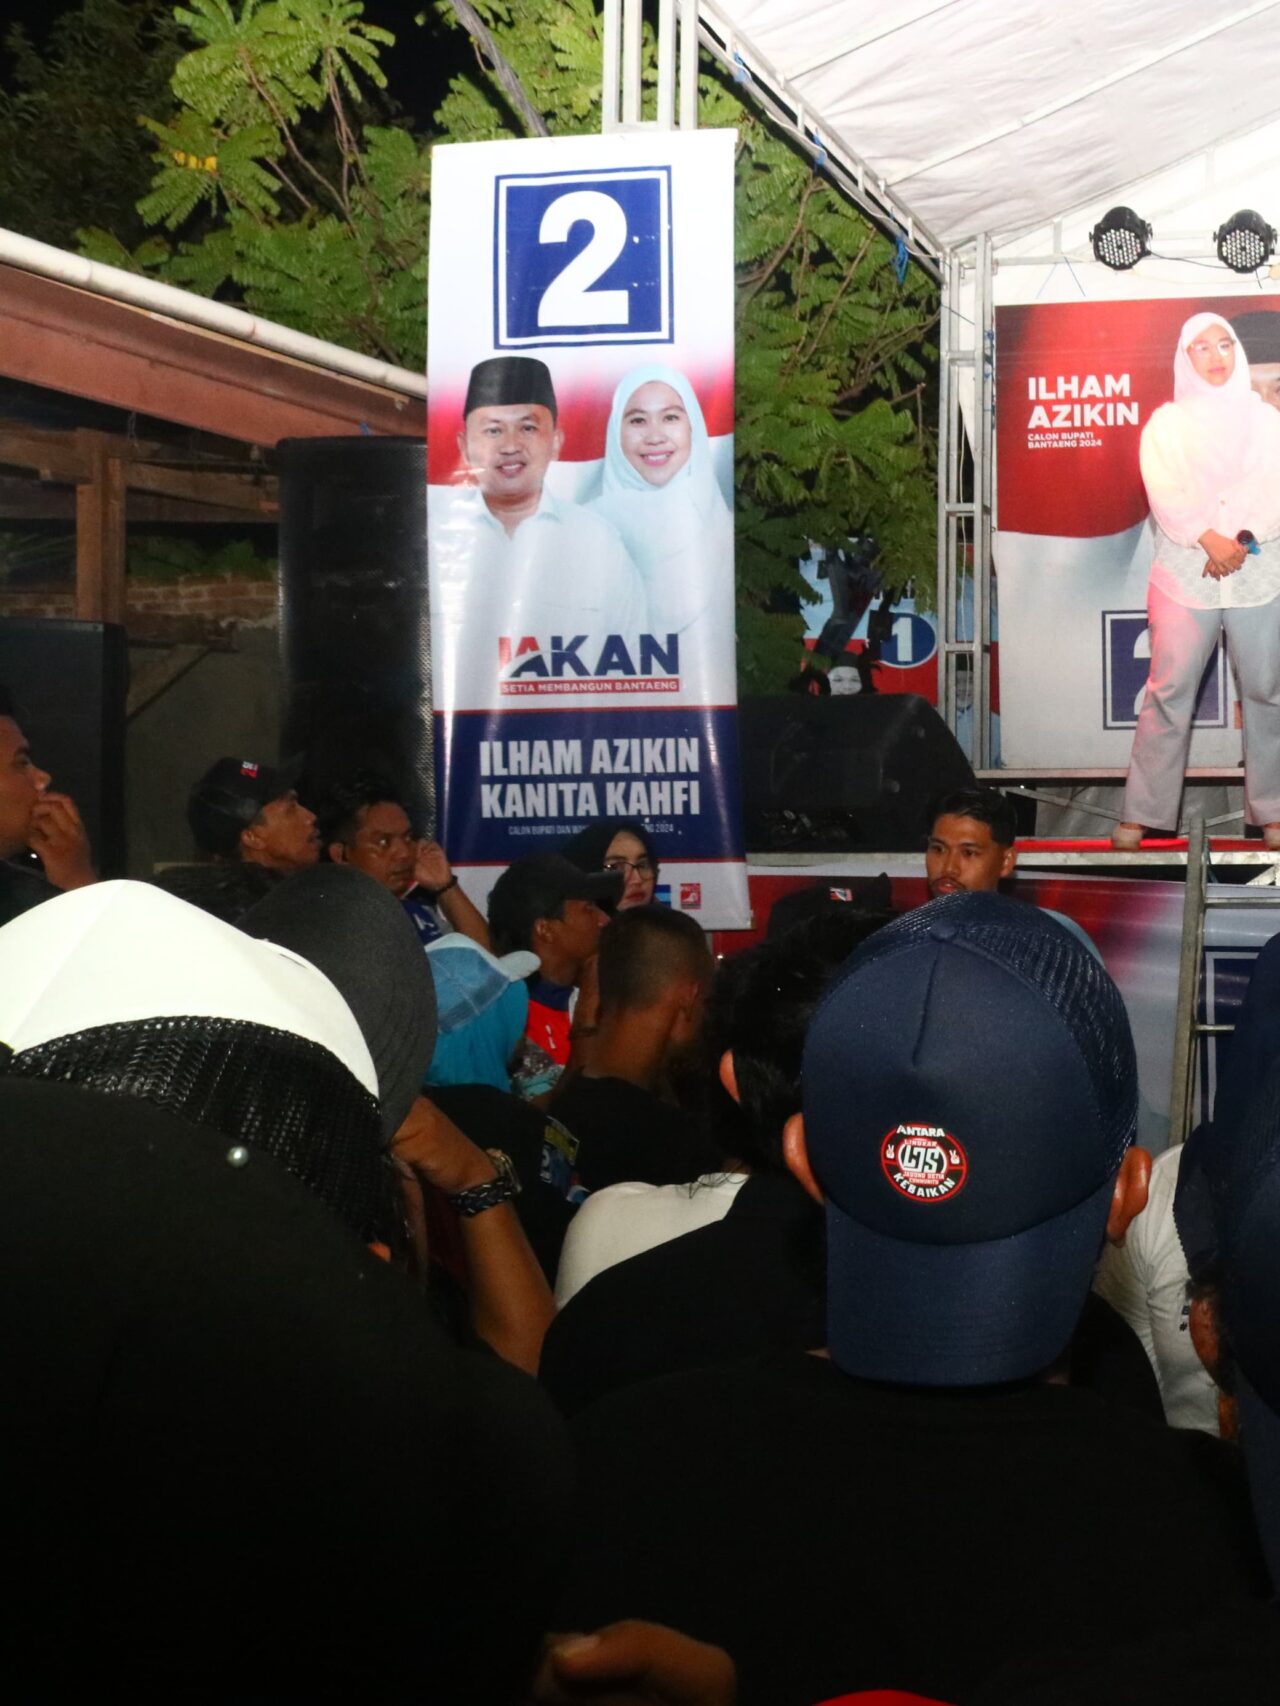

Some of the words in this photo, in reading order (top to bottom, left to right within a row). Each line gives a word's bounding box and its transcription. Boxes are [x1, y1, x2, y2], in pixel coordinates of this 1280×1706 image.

[538, 190, 629, 327] 2
[1028, 373, 1131, 400] ILHAM
[1027, 402, 1139, 429] AZIKIN
[1028, 433, 1059, 441] CALON
[1028, 440, 1077, 449] BANTAENG
[1079, 439, 1102, 447] 2024
[891, 617, 913, 662] 1
[503, 684, 535, 694] SETIA
[538, 682, 612, 693] MEMBANGUN
[615, 681, 677, 691] BANTAENG
[480, 739, 582, 776] ILHAM
[590, 737, 699, 774] AZIKIN
[481, 782, 599, 818] KANITA
[606, 780, 700, 816] KAHFI
[896, 1124, 946, 1138] ANTARA
[893, 1172, 956, 1198] KEBAIKAN
